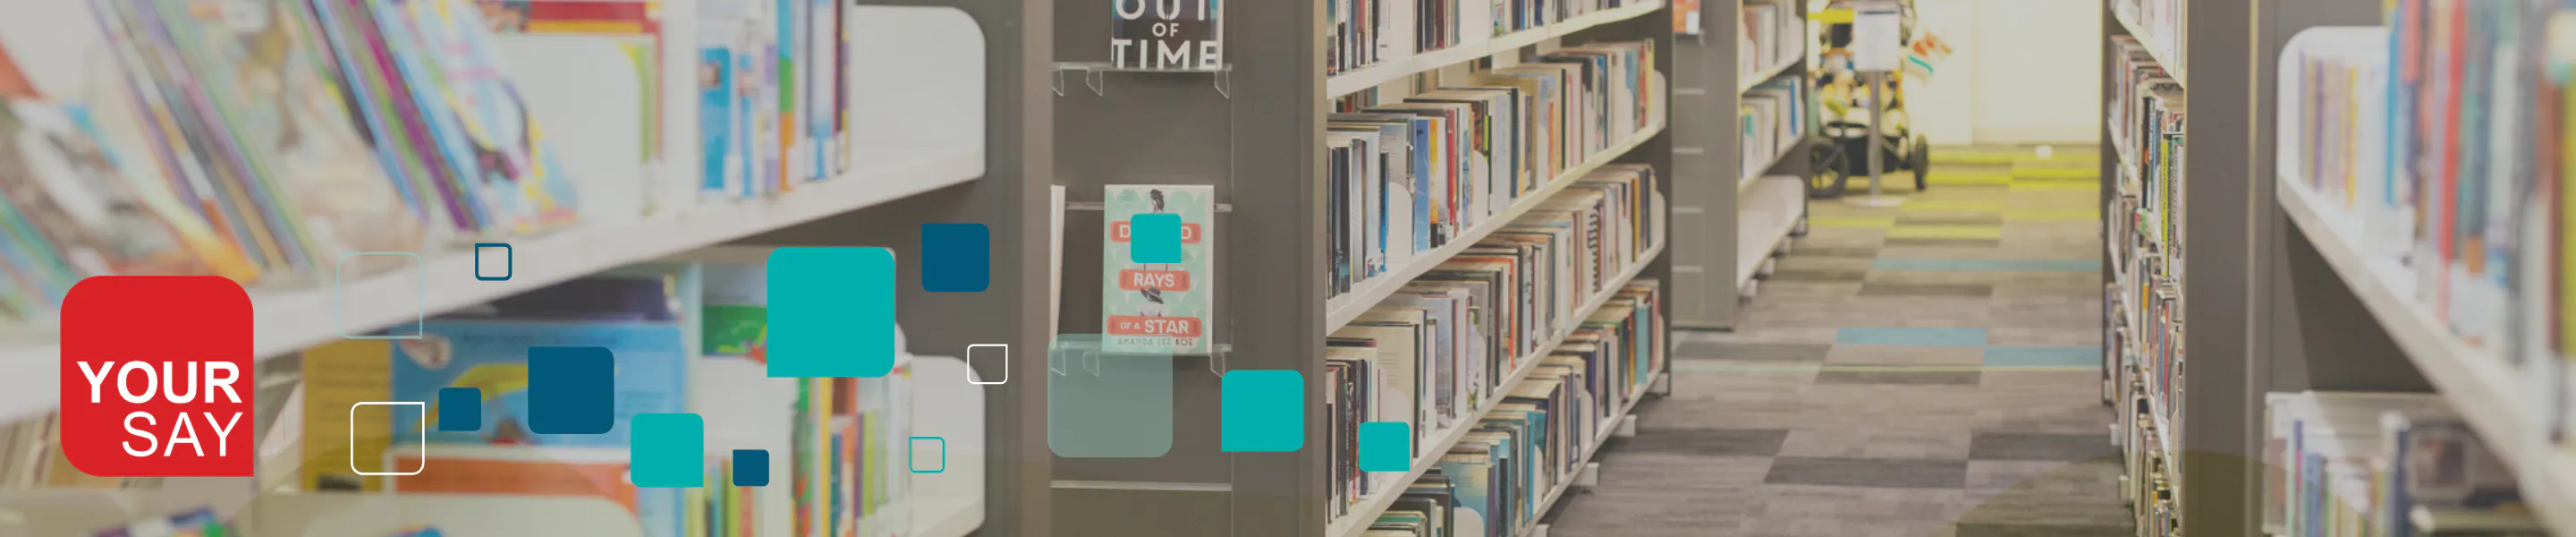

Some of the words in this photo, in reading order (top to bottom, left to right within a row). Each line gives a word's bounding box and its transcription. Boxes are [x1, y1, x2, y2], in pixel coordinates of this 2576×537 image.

[1152, 22, 1179, 38] OF
[1112, 38, 1218, 70] TIME
[1133, 272, 1174, 287] RAYS
[1134, 321, 1141, 330] A
[1145, 319, 1189, 334] STAR
